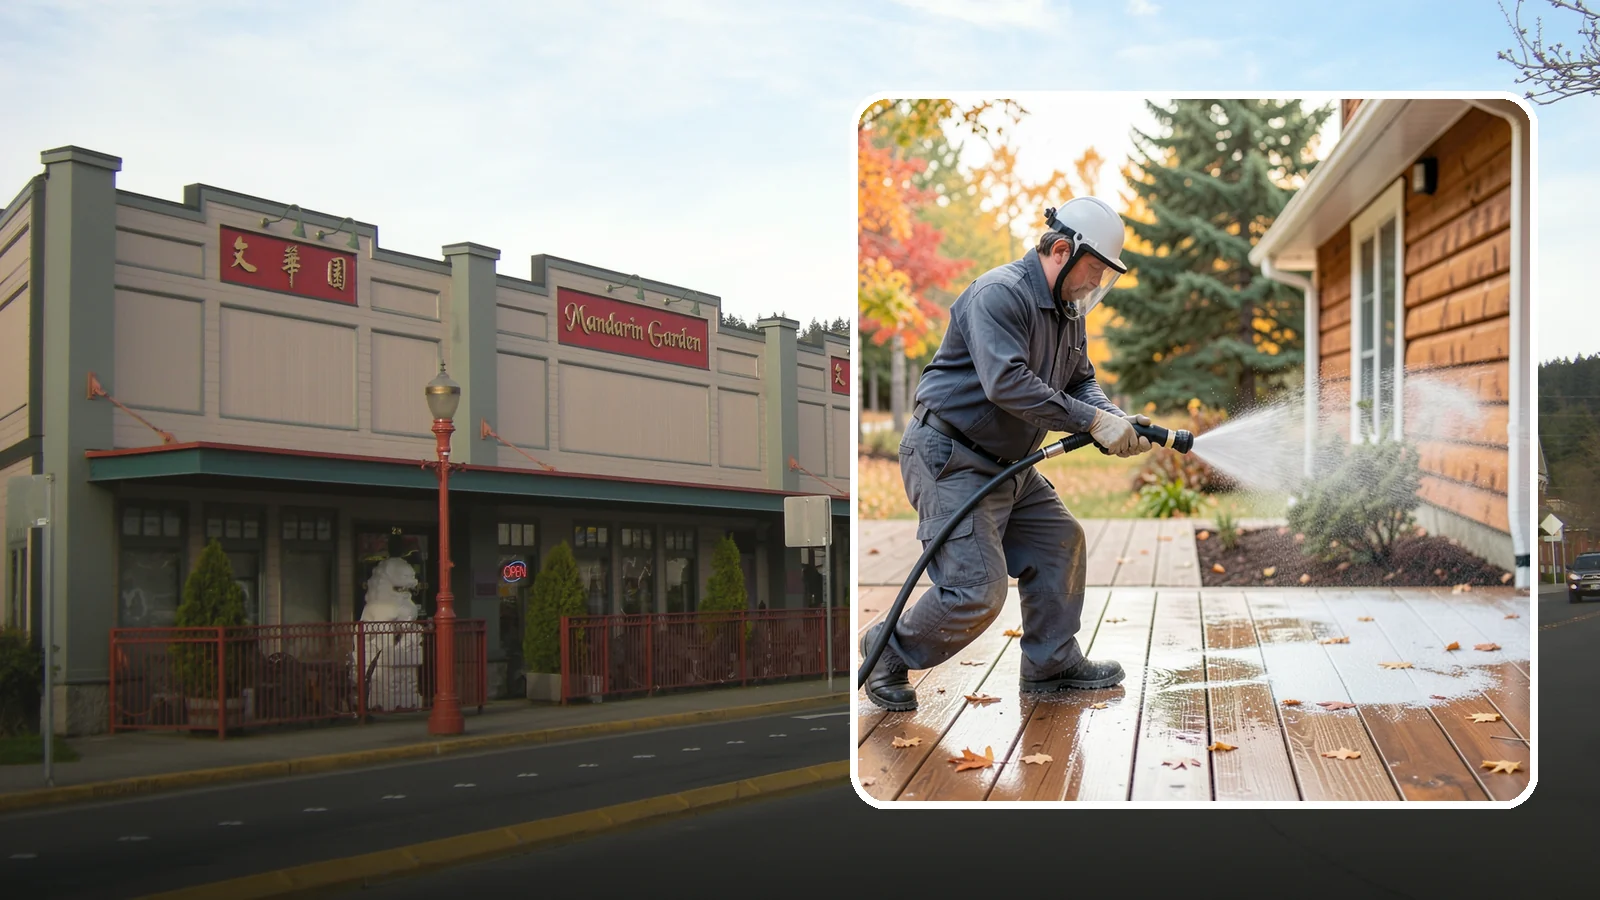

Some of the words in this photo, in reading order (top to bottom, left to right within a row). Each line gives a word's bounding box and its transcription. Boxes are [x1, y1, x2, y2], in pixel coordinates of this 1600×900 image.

[564, 302, 644, 341] Mandarin
[647, 320, 701, 352] Garden
[503, 565, 527, 578] OPEN
